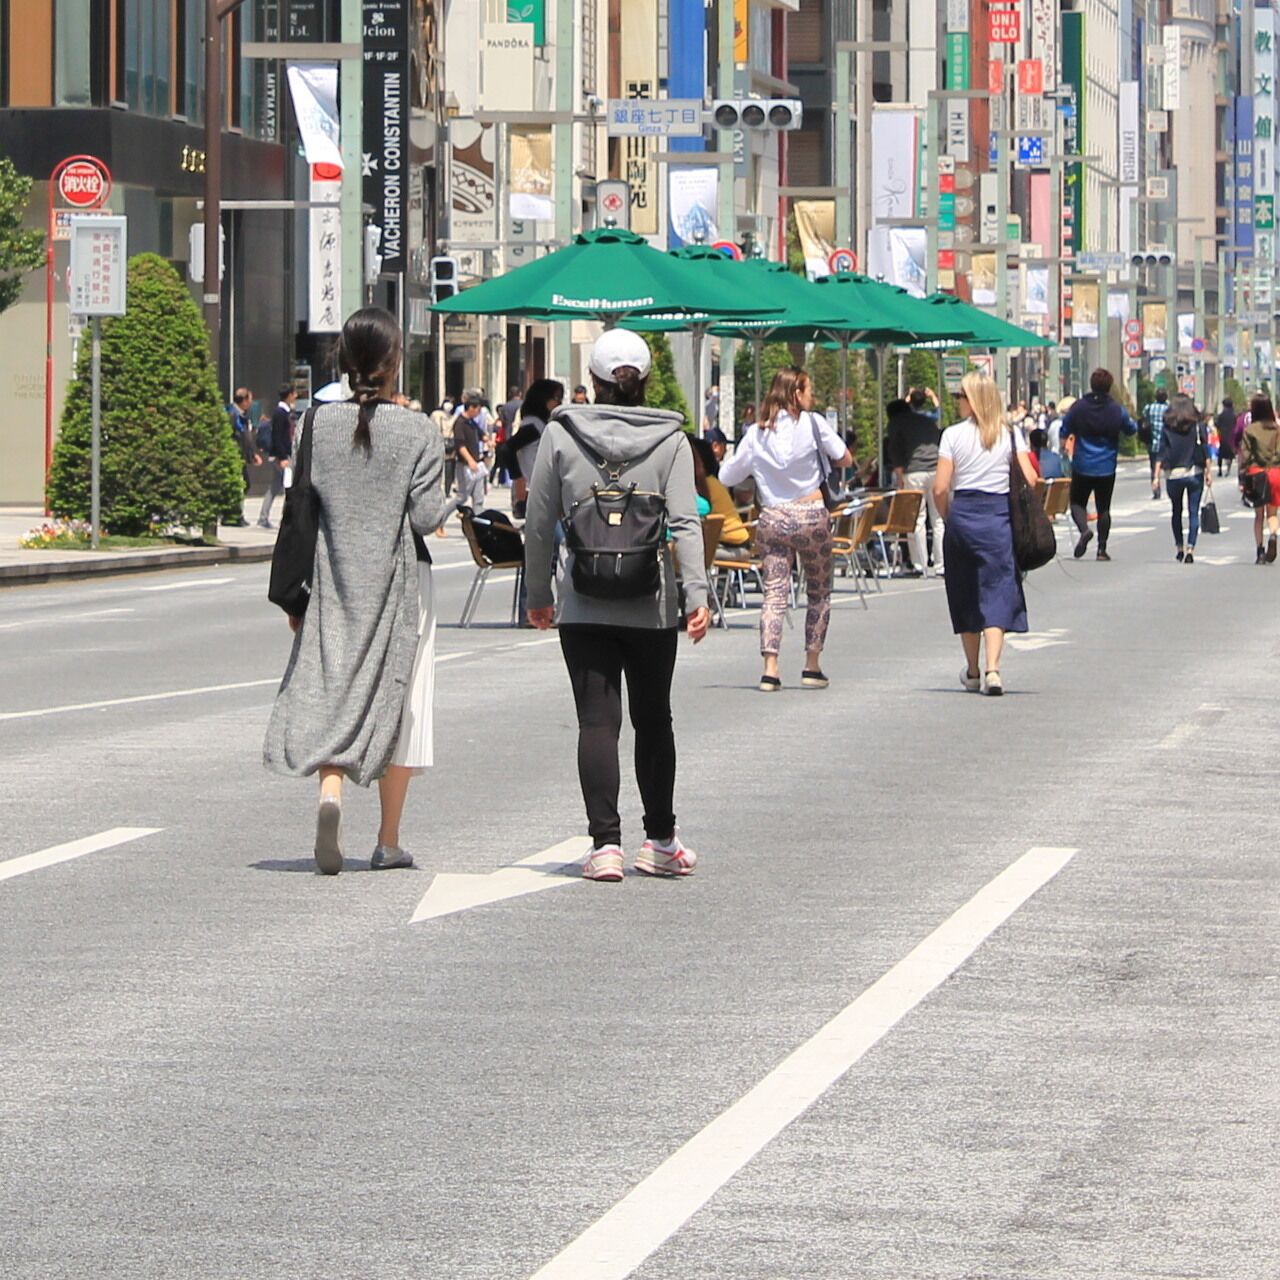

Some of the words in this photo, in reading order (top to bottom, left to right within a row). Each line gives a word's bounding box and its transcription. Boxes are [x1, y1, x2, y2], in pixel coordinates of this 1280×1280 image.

[991, 14, 1016, 25] UNI
[991, 27, 1018, 39] QLO
[1254, 30, 1273, 140] 教文館
[384, 72, 401, 170] CONSTANTIN
[614, 108, 696, 124] 銀座七丁目
[638, 124, 662, 133] Ginza
[665, 124, 670, 133] 7
[64, 175, 99, 193] 消火栓
[384, 175, 401, 260] VACHERON
[1255, 199, 1273, 224] 本
[551, 293, 654, 309] ExcelHuman
